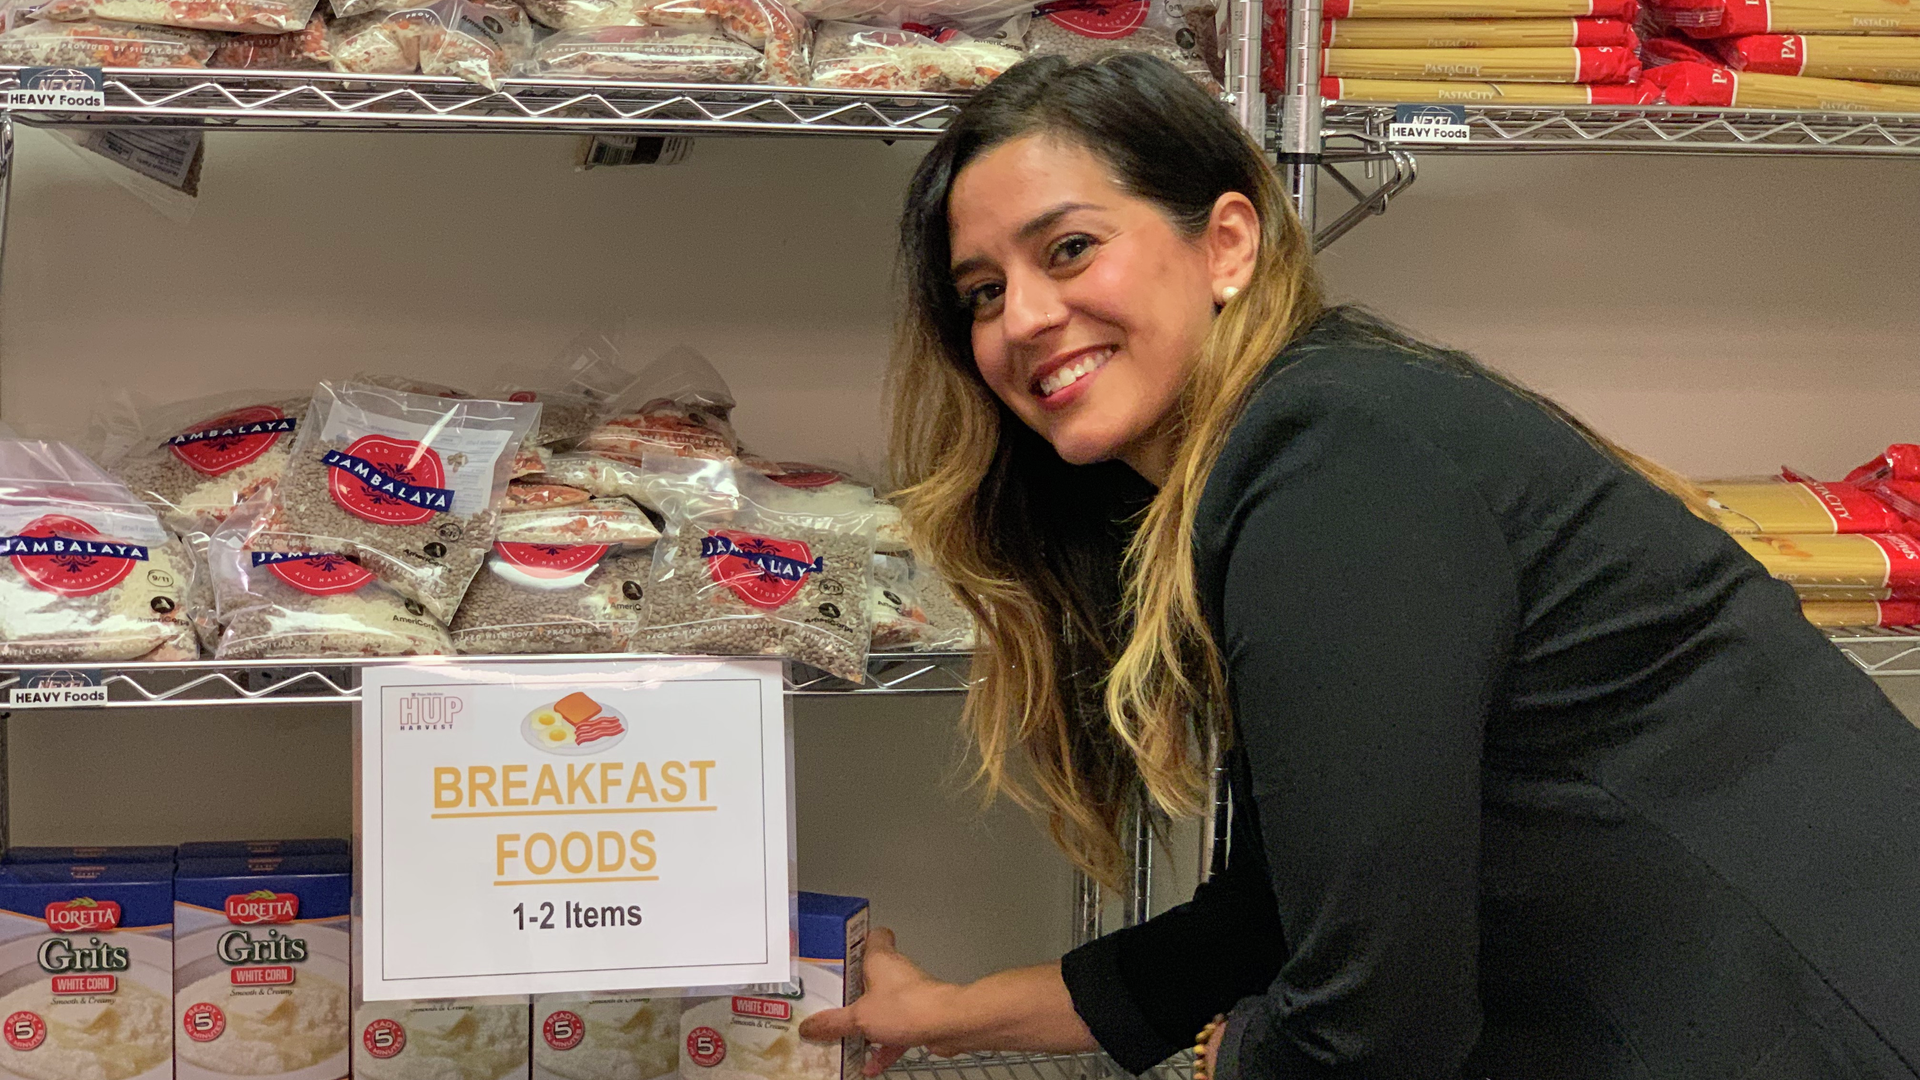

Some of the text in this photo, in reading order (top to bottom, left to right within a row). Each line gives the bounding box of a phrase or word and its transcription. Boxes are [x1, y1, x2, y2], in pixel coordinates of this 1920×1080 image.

[62, 42, 110, 51] PROVIDED
[10, 94, 100, 106] HEAVY Foods
[1438, 90, 1494, 100] PASTACITY
[1392, 127, 1467, 138] HEAVY Foods
[174, 422, 290, 444] AMBALAYA
[328, 455, 446, 508] JAMBALAYA
[360, 503, 406, 516] NATURAL
[2, 540, 143, 558] JAMBALAYA
[520, 550, 586, 566] ALL NATURAL
[39, 568, 110, 584] ALL NATURAL
[295, 568, 360, 582] ALL NATURA
[611, 602, 642, 611] AmeriC
[136, 616, 190, 627] AmeriCorps
[804, 618, 854, 634] AmeriCorps
[454, 633, 482, 645] ACKED
[486, 630, 510, 640] WITH
[512, 630, 534, 638] LOVE
[547, 627, 592, 636] PROVIDED
[646, 631, 679, 640] PACKED
[741, 622, 775, 630] PROVID
[30, 648, 54, 656] LOVE
[16, 690, 105, 703] HEAVY Foods
[400, 696, 464, 725] HUP
[434, 760, 716, 808] BREAKFAST
[496, 829, 657, 876] FOODS
[50, 908, 115, 924] LORETTA
[230, 900, 294, 916] LORETTA
[513, 900, 642, 930] 1-2 Items
[38, 938, 128, 972] Grits
[218, 930, 306, 964] Grits
[57, 977, 110, 991] WHITE CORN
[236, 970, 288, 982] WHITE CORN
[230, 988, 256, 996] Smooth
[267, 988, 294, 996] Creamy
[88, 997, 116, 1005] Creamy
[736, 999, 784, 1016] WHITE CORN
[8, 1012, 37, 1024] READY
[188, 1005, 216, 1016] READY
[548, 1012, 576, 1024] READY
[195, 1013, 214, 1030] 5
[368, 1020, 398, 1033] READY
[16, 1021, 34, 1040] 5
[186, 1021, 222, 1039] IN MINUTES
[375, 1029, 394, 1047] 5
[554, 1021, 572, 1039] 5
[6, 1030, 43, 1048] IN MINUTES
[366, 1038, 402, 1055] IN MINUTES
[546, 1029, 582, 1048] IN MINUTES
[698, 1038, 714, 1054] 5
